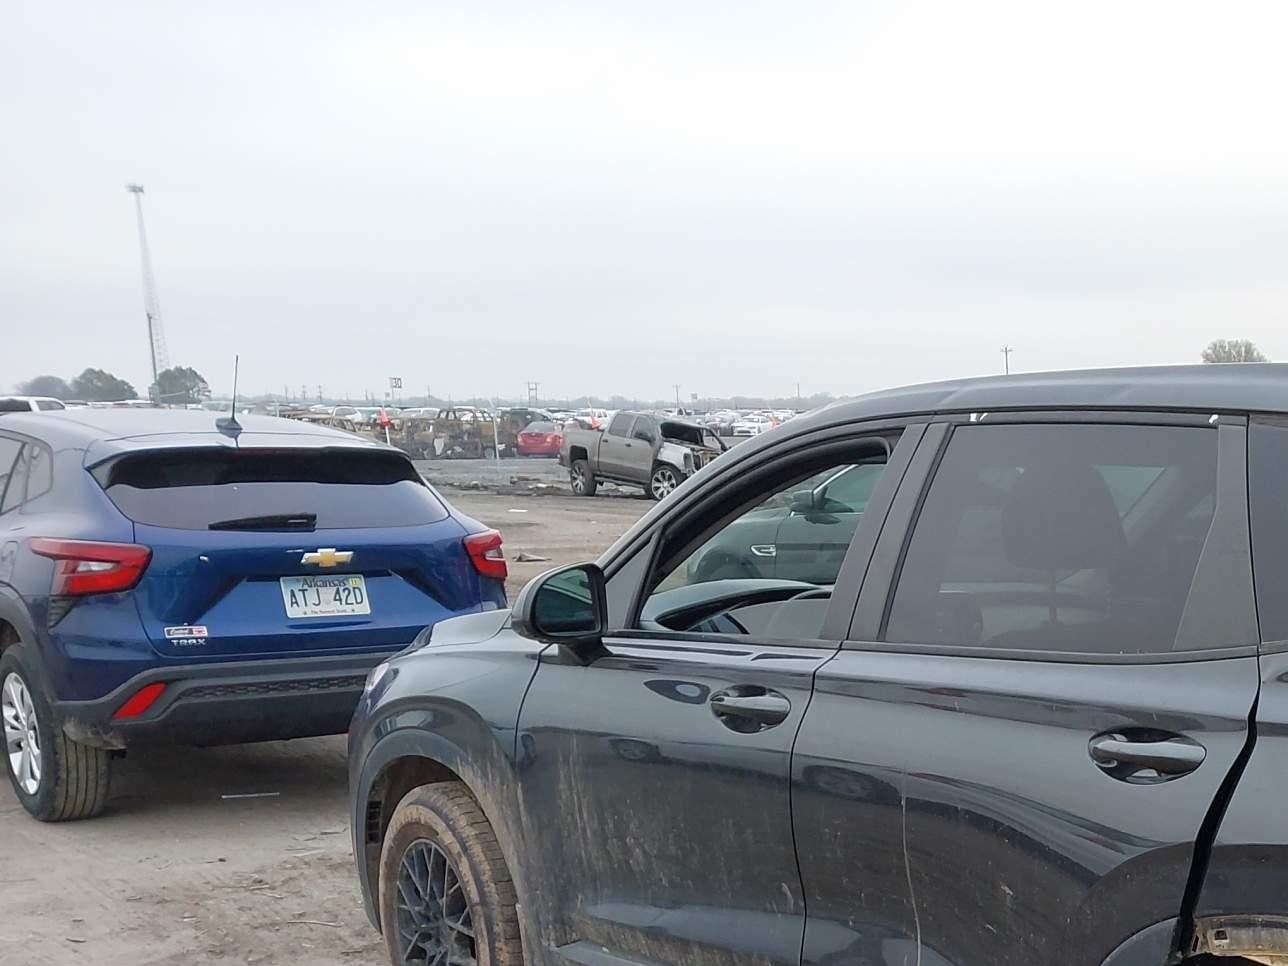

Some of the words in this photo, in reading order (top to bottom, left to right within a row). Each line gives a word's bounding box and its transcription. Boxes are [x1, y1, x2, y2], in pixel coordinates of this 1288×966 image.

[301, 577, 347, 588] Arkansas
[290, 588, 321, 608] ATJ
[333, 587, 364, 606] 42D
[170, 639, 206, 647] TRAX
